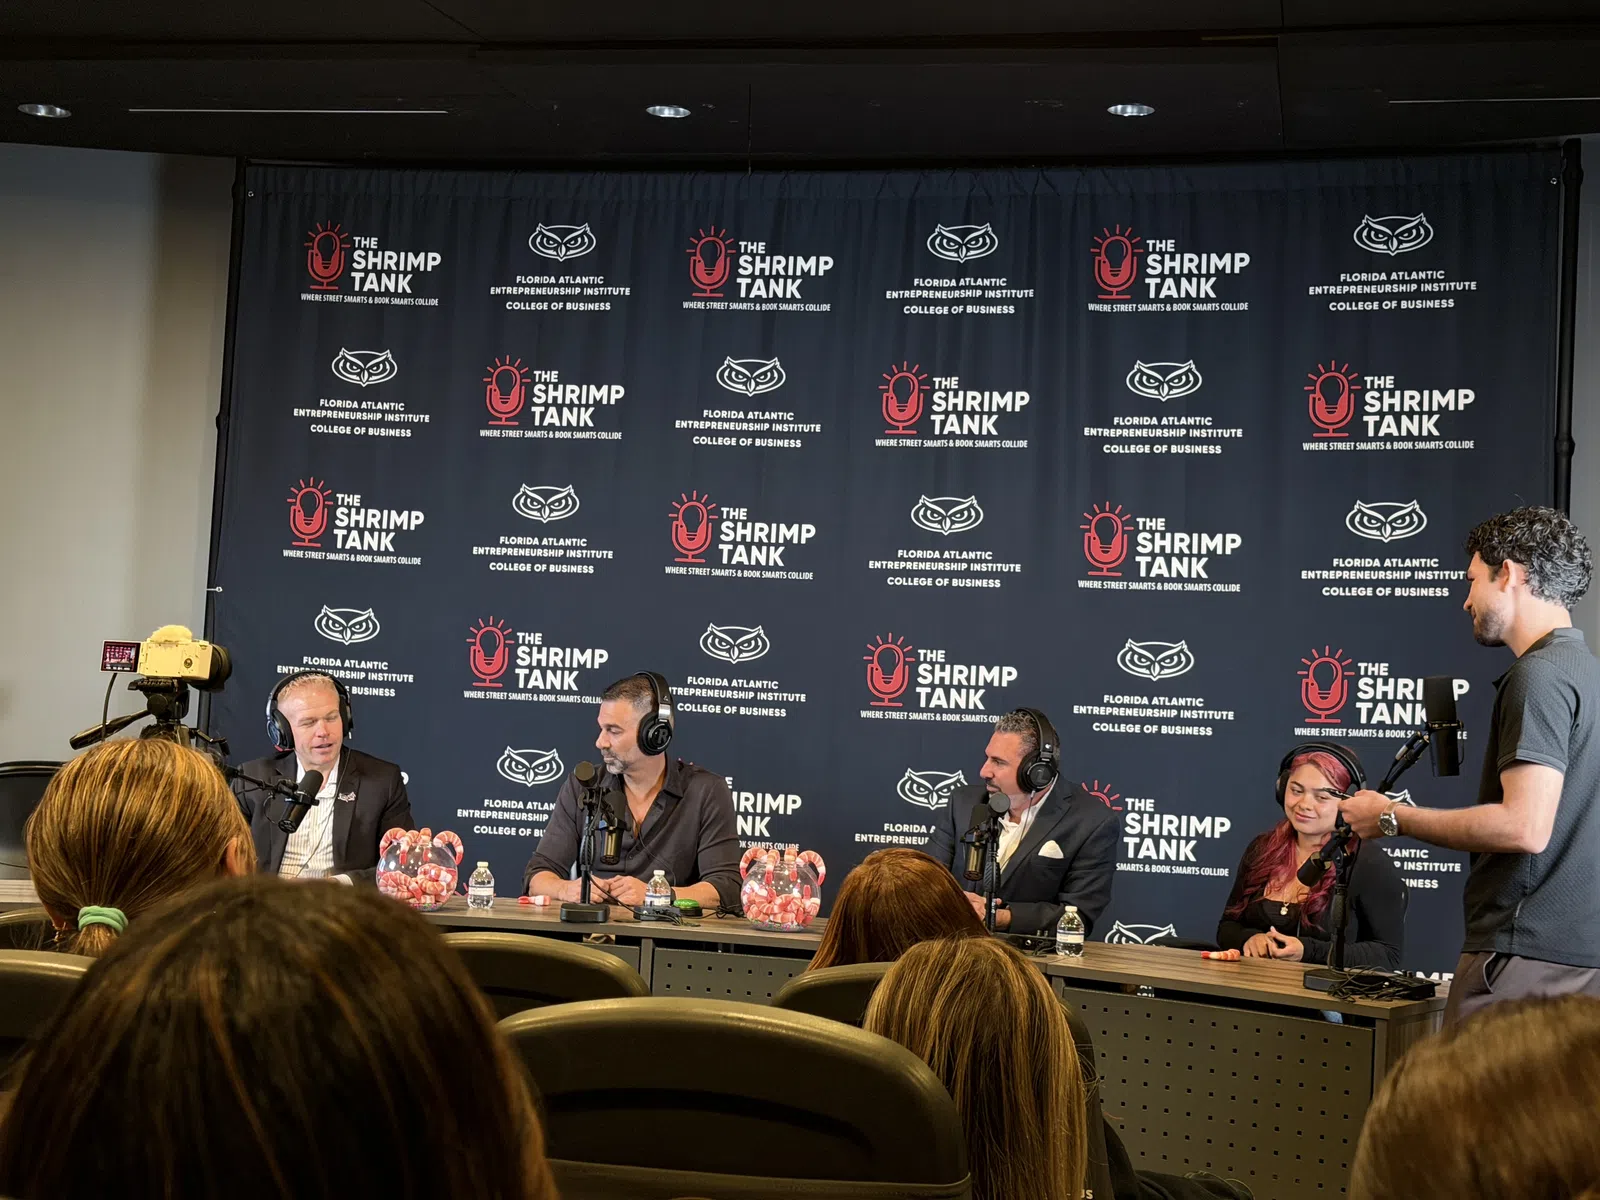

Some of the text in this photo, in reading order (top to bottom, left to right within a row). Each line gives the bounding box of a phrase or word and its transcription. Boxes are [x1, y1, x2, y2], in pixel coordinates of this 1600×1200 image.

[353, 237, 378, 248] THE
[739, 242, 766, 253] THE
[1146, 240, 1175, 252] THE
[352, 250, 441, 271] SHRIMP
[738, 255, 833, 276] SHRIMP
[1146, 253, 1250, 275] SHRIMP
[351, 272, 412, 293] TANK
[516, 276, 604, 284] FLORIDA ATLANTIC
[914, 278, 1006, 286] FLORIDA ATLANTIC
[1341, 271, 1444, 282] FLORIDA ATLANTIC
[490, 287, 581, 295] ENTREPRENEURSHIP
[737, 278, 802, 298] TANK
[1145, 277, 1216, 298] TANK
[1309, 282, 1476, 294] ENTREPRENEURSHIP INSTITUTE
[886, 290, 1034, 298] ENTREPRENEURSHIP INSTITUTE
[506, 302, 610, 310] COLLEGE OF BUSINESS
[904, 306, 1014, 314] COLLEGE OF BUSINESS
[1173, 303, 1191, 311] BOOK
[1329, 299, 1454, 310] COLLEGE OF BUSINESS
[534, 371, 558, 382] THE
[1364, 376, 1394, 389] THE
[933, 377, 958, 389] THE
[533, 384, 624, 404] SHRIMP
[320, 399, 404, 410] FLORIDA ATLANTIC
[932, 391, 1030, 412] SHRIMP
[1364, 389, 1474, 412] SHRIMP
[294, 409, 429, 422] ENTREPRENEURSHIP INSTITUTE
[532, 406, 594, 426] TANK
[704, 410, 794, 420] FLORIDA ATLANTIC
[1114, 417, 1212, 425] FLORIDA ATLANTIC
[676, 421, 821, 432] ENTREPRENEURSHIP INSTITUTE
[931, 414, 998, 435] TANK
[1363, 414, 1440, 436] TANK
[311, 425, 351, 434] COLLEGE
[368, 428, 411, 437] BUSINESS
[1084, 428, 1242, 437] ENTREPRENEURSHIP INSTITUTE
[693, 437, 801, 447] COLLEGE OF BUSINESS
[1103, 445, 1221, 454] COLLEGE OF BUSINESS
[336, 494, 361, 506] THE
[335, 507, 424, 530] SHRIMP
[721, 508, 747, 520] THE
[1136, 518, 1165, 530] THE
[720, 521, 816, 544] SHRIMP
[334, 529, 395, 551] TANK
[500, 536, 587, 546] FLORIDA ATLANTIC
[1136, 532, 1241, 554] SHRIMP
[283, 550, 304, 558] WHERE
[305, 551, 325, 559] STREET
[326, 553, 349, 561] SMARTS
[374, 556, 396, 564] SMARTS
[398, 557, 421, 565] COLLIDE
[473, 547, 613, 558] ENTREPRENEURSHIP INSTITUTE
[719, 544, 784, 566] TANK
[898, 550, 992, 559] FLORIDA ATLANTIC
[490, 563, 594, 573] COLLEGE OF BUSINESS
[869, 561, 1021, 572] ENTREPRENEURSHIP INSTITUTE
[1136, 556, 1208, 578] TANK
[1333, 559, 1438, 567] FLORIDA ATLANTIC
[1302, 571, 1466, 579] ENTREPRENEURSHIP INSTITUT
[887, 577, 1000, 587] COLLEGE OF BUSINESS
[1322, 587, 1449, 596] COLLEGE OF BUSINESS
[517, 633, 542, 644] THE
[516, 646, 608, 668] SHRIMP
[918, 650, 945, 662] THE
[303, 657, 388, 670] FLORIDA ATLANTIC
[1358, 663, 1388, 675] THE
[368, 672, 413, 682] INSTITUTE
[515, 668, 578, 690] TANK
[917, 664, 1017, 686] SHRIMP
[688, 677, 778, 689] FLORIDA ATLANTIC
[1357, 678, 1469, 700] SHRIP
[352, 686, 395, 696] BUSINESS
[669, 687, 806, 702] TREPRENEURSHIP INSTITUTE
[916, 687, 985, 709] TANK
[1104, 695, 1204, 706] FLORIDA ATLANTIC
[677, 703, 786, 716] COLLEGE OF BUSINESS
[1074, 706, 1234, 719] ENTREPRENEURSHIP INSTITUTE
[1356, 702, 1426, 725] TANK
[1093, 723, 1212, 735] COLLEGE OF BUSINESS
[484, 799, 556, 810] FLORIDA ATLAN
[732, 792, 802, 814] RIMP
[1125, 798, 1154, 811] THE
[457, 809, 548, 821] ENTREPRENEURSHIP
[474, 826, 516, 835] COLLEGE
[519, 828, 531, 836] OF
[737, 815, 770, 837] NK
[884, 824, 927, 833] FLORIDA
[1125, 813, 1230, 838] SHRIMP
[1124, 837, 1196, 861] TANK
[1116, 863, 1228, 876] SMARTS & BOOK SMARTS COLLIDE
[1404, 862, 1460, 872] INSTITUTE
[1402, 878, 1438, 888] INESS
